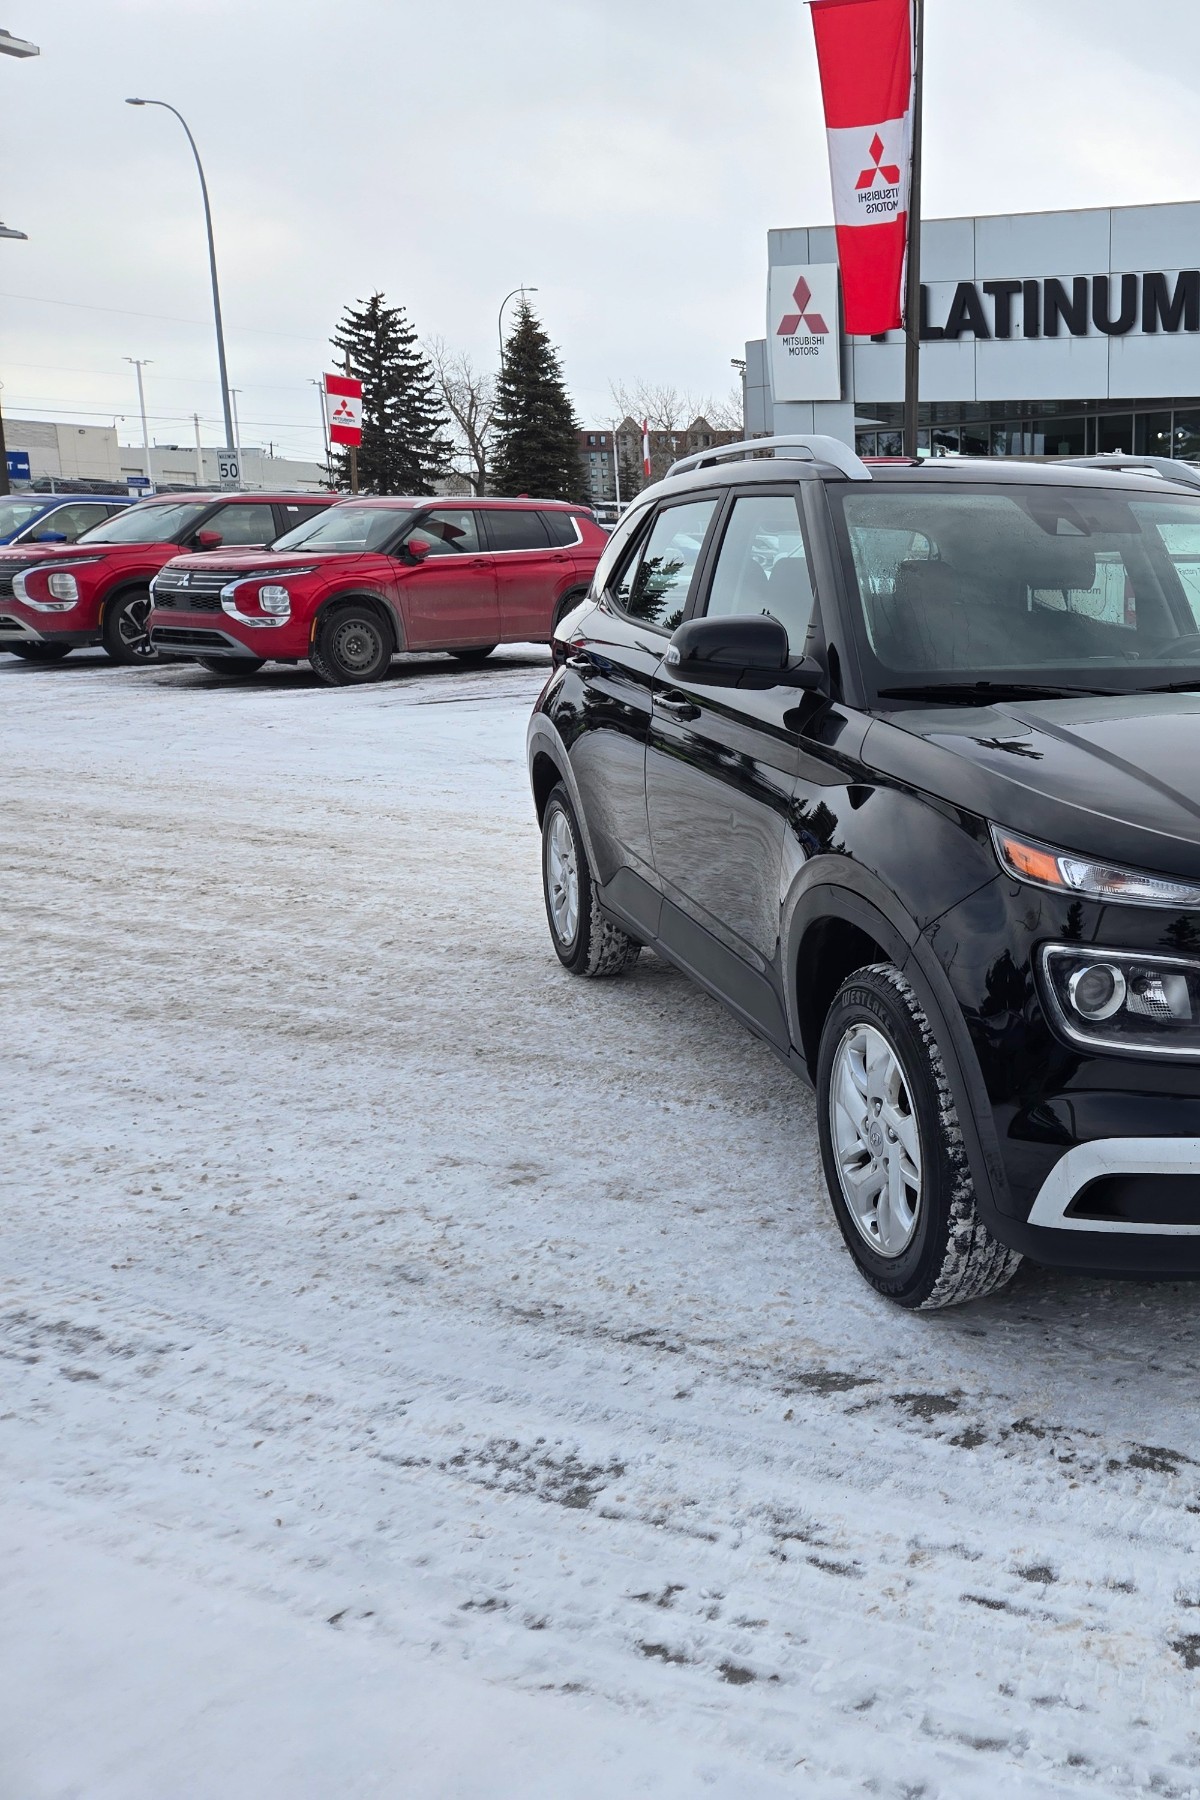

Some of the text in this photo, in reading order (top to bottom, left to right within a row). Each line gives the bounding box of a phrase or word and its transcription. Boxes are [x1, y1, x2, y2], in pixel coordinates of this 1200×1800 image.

[871, 270, 1200, 342] LATINUM
[782, 336, 825, 346] MITSUBISHI
[789, 347, 819, 356] MOTORS
[220, 463, 238, 478] 50
